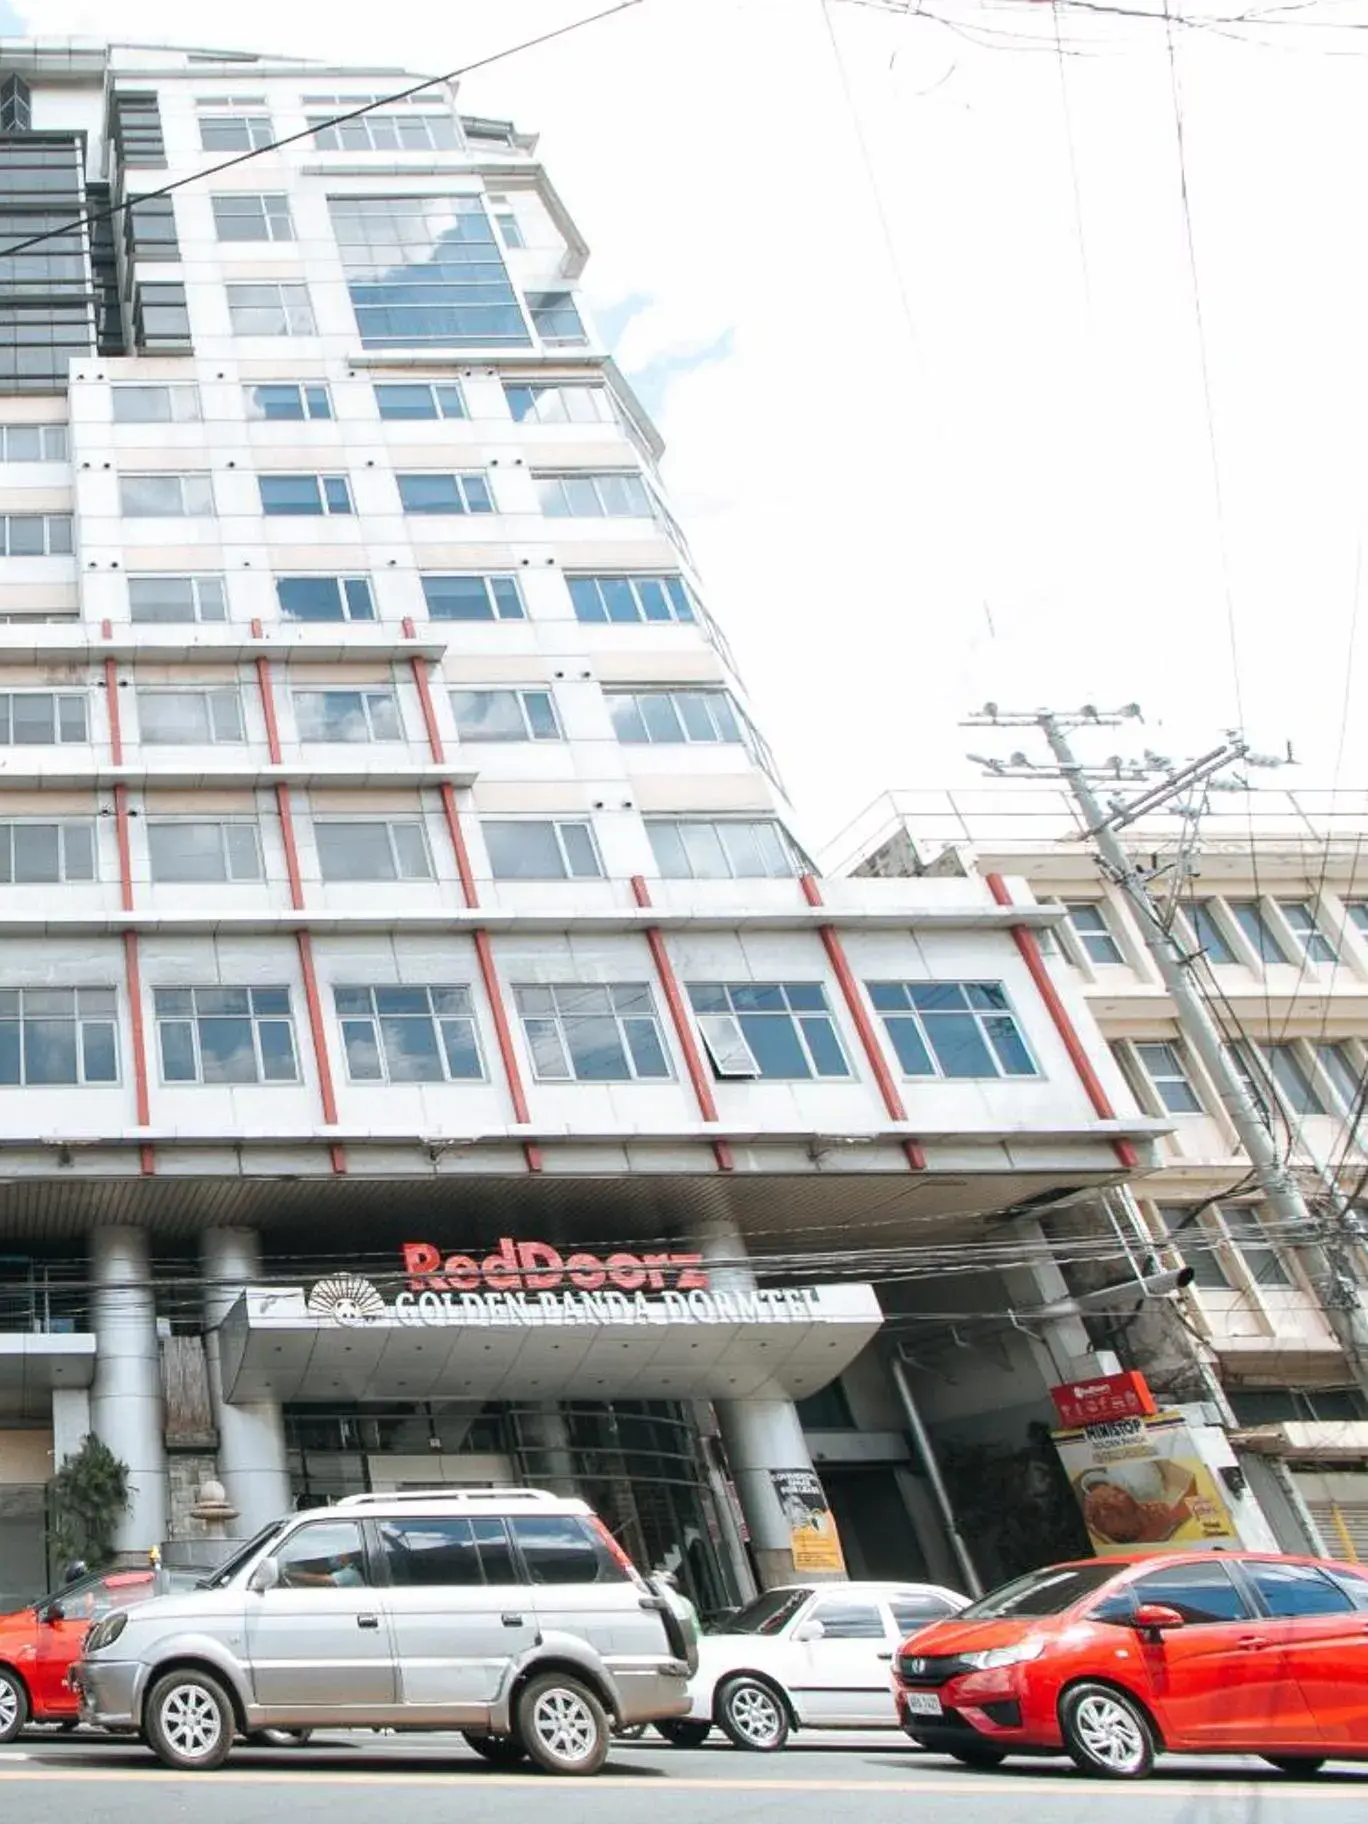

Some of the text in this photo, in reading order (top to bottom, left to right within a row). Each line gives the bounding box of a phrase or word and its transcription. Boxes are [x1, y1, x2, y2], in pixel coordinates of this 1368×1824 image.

[403, 1237, 708, 1290] RedDoorz
[395, 1289, 819, 1326] GOLDEN PANDA DORMTEL
